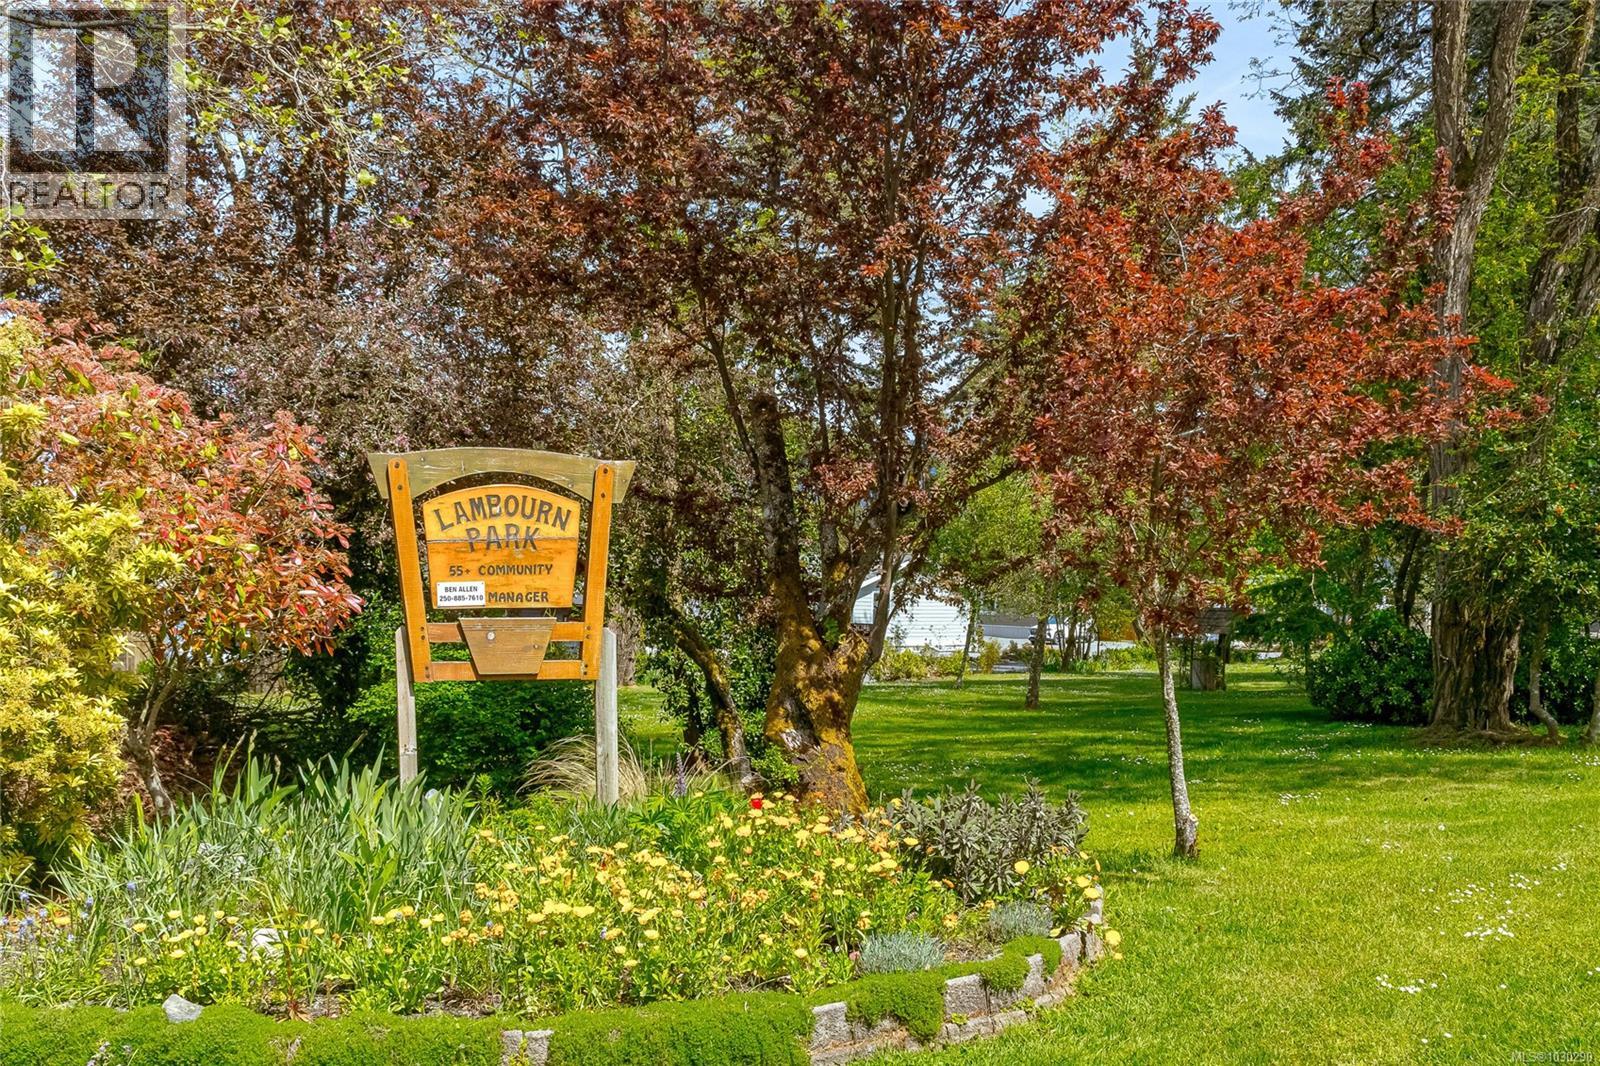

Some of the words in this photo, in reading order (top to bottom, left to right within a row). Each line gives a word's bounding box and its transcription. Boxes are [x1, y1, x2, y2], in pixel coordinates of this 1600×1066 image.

[433, 494, 572, 532] LAMBOURN
[465, 523, 541, 553] PARK
[449, 565, 471, 577] 55+
[478, 564, 553, 576] COMMUNITY
[439, 594, 484, 602] 250-885-7610
[488, 591, 549, 603] MANAGER
